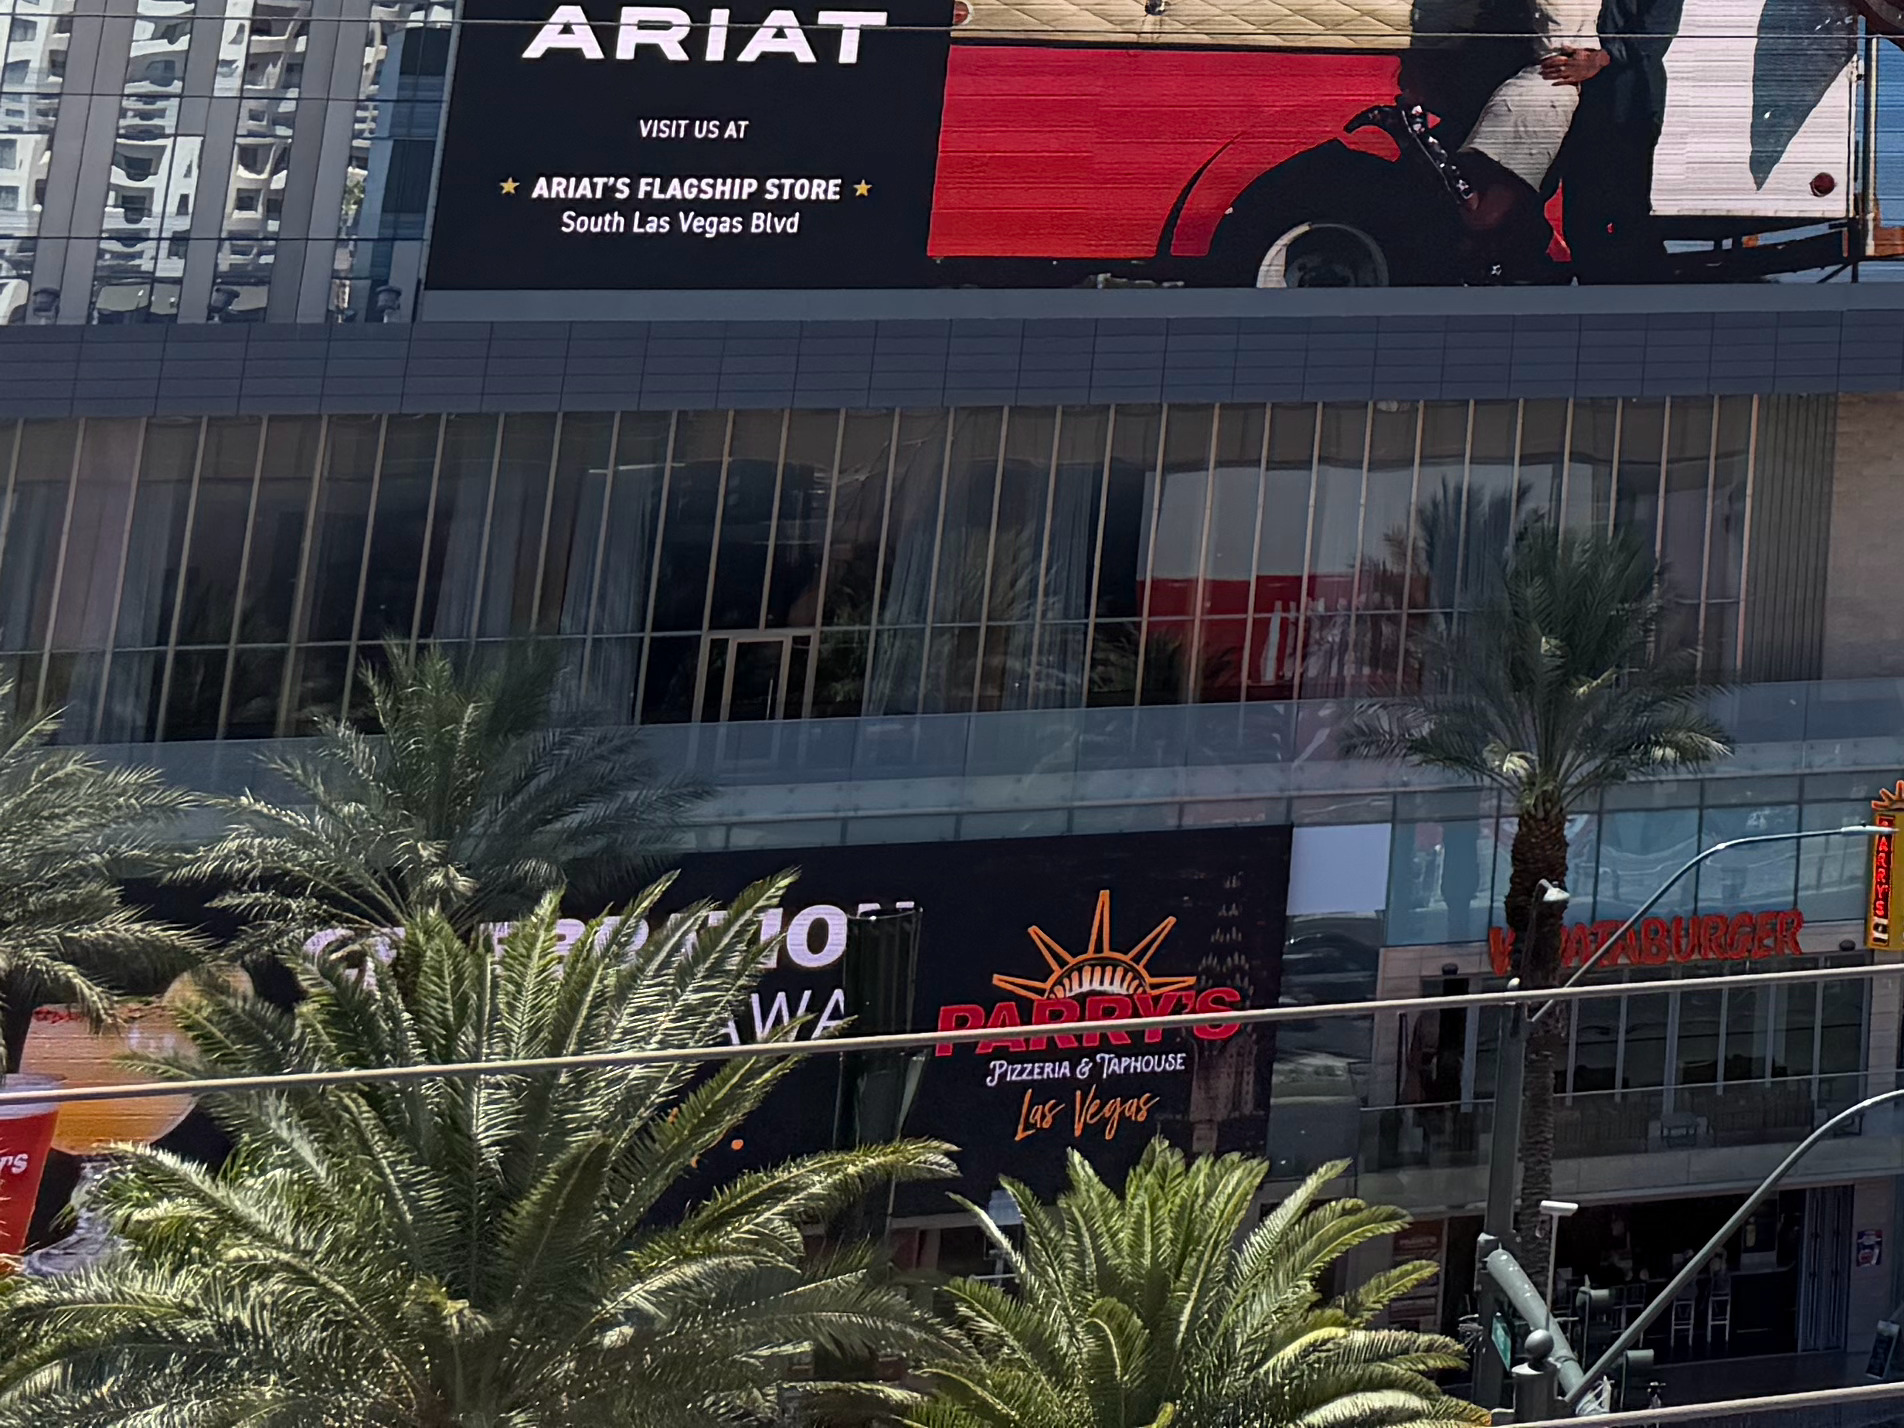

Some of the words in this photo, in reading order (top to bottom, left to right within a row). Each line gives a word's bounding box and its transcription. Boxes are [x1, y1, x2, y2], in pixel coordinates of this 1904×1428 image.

[522, 5, 888, 64] ARIAT
[639, 119, 689, 138] VISIT
[694, 120, 720, 139] US
[724, 121, 749, 139] AT
[638, 177, 758, 200] FLAGSHIP
[764, 178, 842, 200] STORE
[561, 210, 625, 234] South
[632, 211, 670, 234] Las
[679, 213, 743, 238] Vegas
[751, 212, 800, 235] Blvd
[934, 987, 1242, 1057] PARRY'S
[986, 1059, 1070, 1087] PIZZERIA
[1075, 1058, 1093, 1079] &
[1096, 1053, 1186, 1079] TAPHOUSE
[1014, 1088, 1066, 1141] Las
[1074, 1083, 1161, 1141] Vegas
